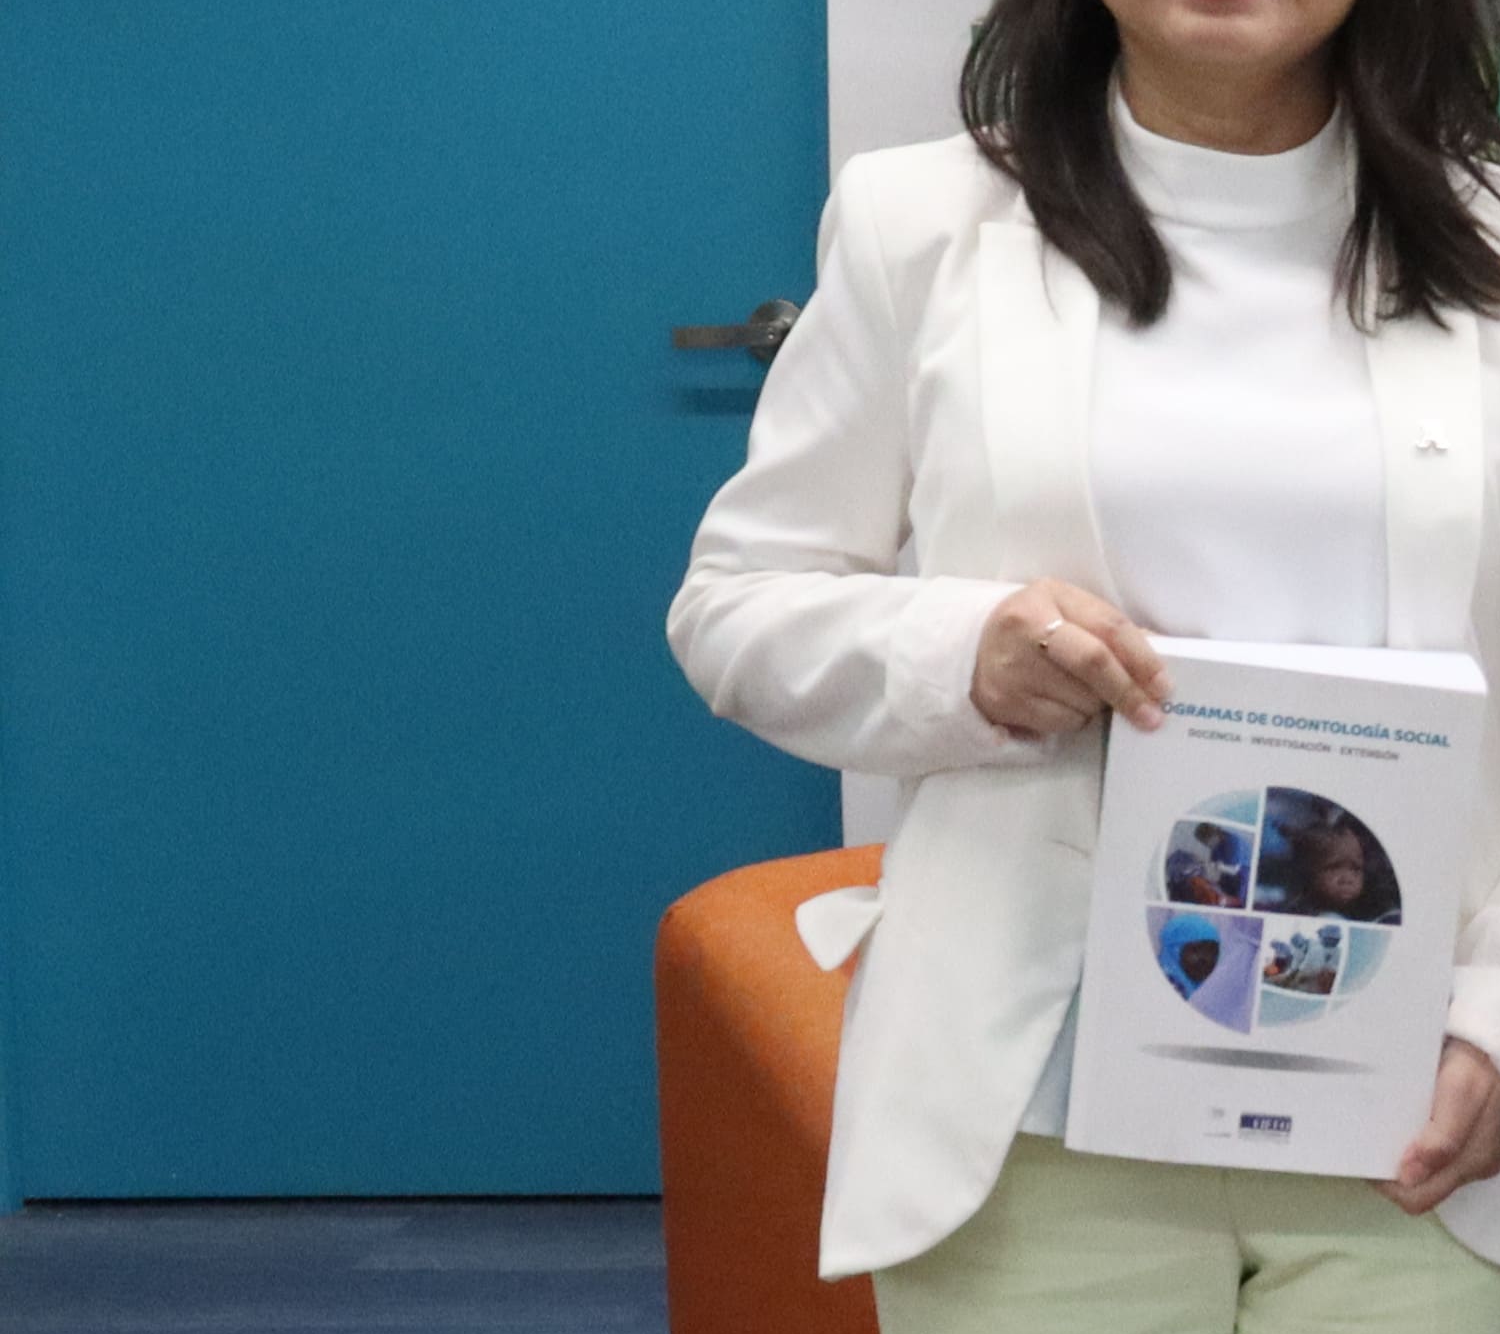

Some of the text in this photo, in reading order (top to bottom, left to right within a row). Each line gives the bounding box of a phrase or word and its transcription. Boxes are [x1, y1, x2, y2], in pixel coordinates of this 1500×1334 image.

[1161, 702, 1451, 748] OGRAMAS DE ODONTOLOGÍA SOCIAL
[1188, 727, 1399, 761] DOCENCIA INVESTIGACIÓN EXTENSIÓN
